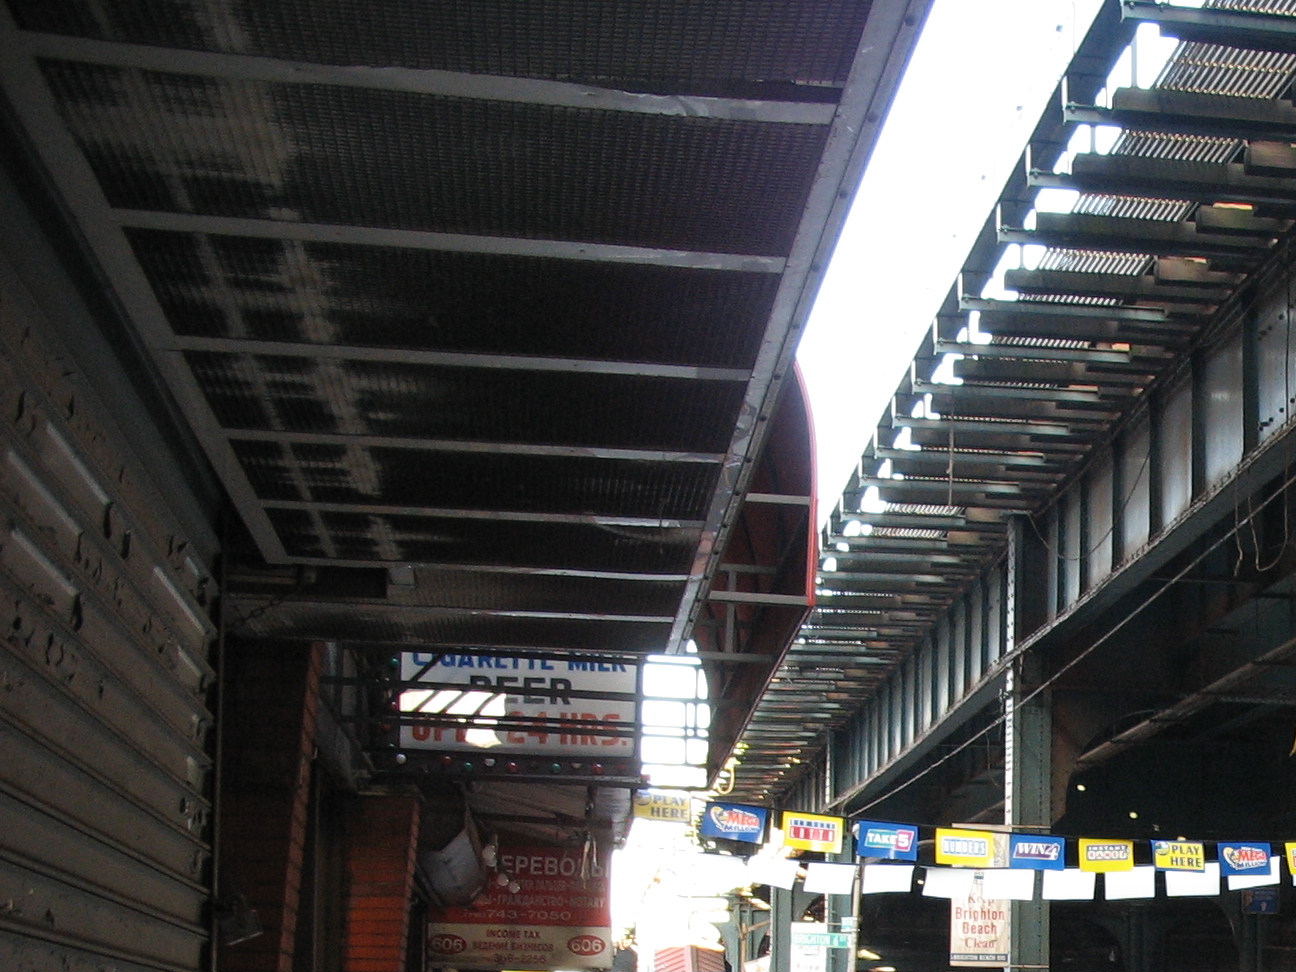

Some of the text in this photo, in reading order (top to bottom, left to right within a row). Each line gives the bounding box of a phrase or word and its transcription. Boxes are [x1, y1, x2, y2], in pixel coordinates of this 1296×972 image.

[470, 674, 573, 706] BEER
[506, 710, 549, 745] 24
[651, 806, 689, 818] HERE
[867, 832, 897, 844] TAKE
[1171, 845, 1200, 856] PLAY
[1170, 856, 1202, 868] HERE
[955, 907, 1005, 922] Brighton
[962, 922, 998, 935] Beach
[571, 938, 602, 952] 606
[965, 937, 995, 949] Clean
